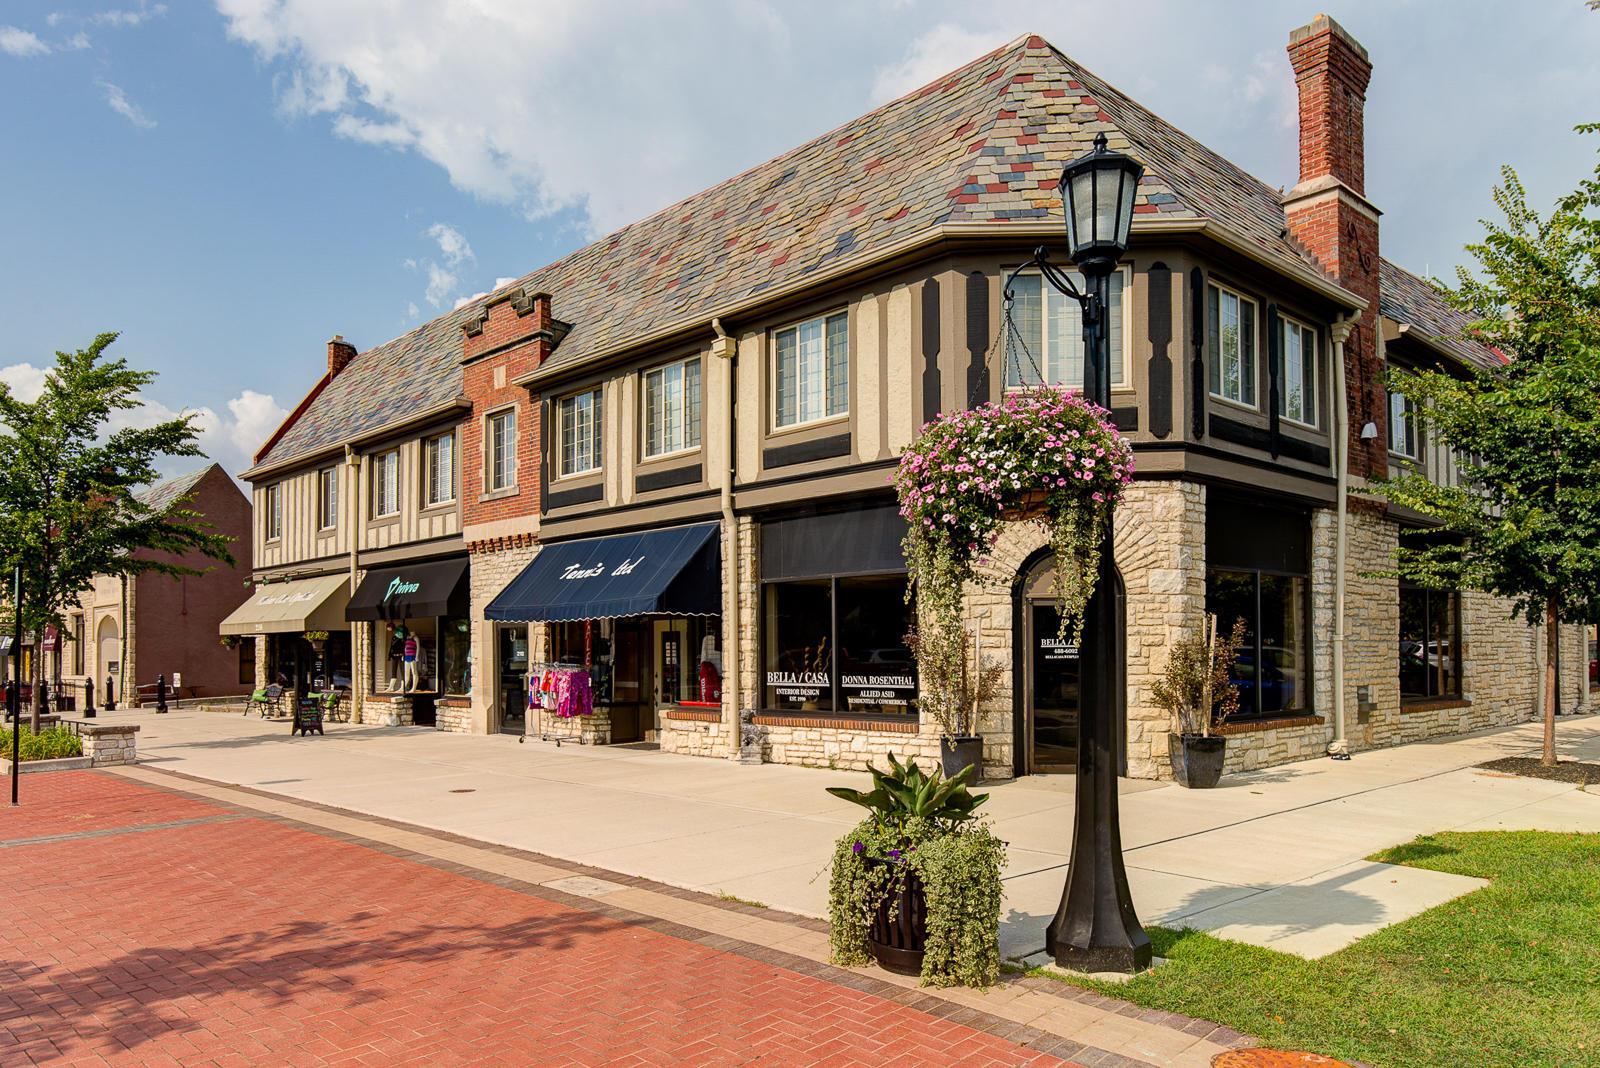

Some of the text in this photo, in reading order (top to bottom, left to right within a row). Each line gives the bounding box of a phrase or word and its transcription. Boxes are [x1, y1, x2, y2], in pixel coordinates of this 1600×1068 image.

[560, 562, 605, 580] Tennis
[1041, 638, 1066, 646] BELLA
[767, 672, 797, 683] BELLA
[805, 672, 830, 684] CASA
[842, 675, 915, 685] DONNA ROSENTHAL
[800, 688, 820, 696] DESIGN
[881, 690, 895, 698] ASID
